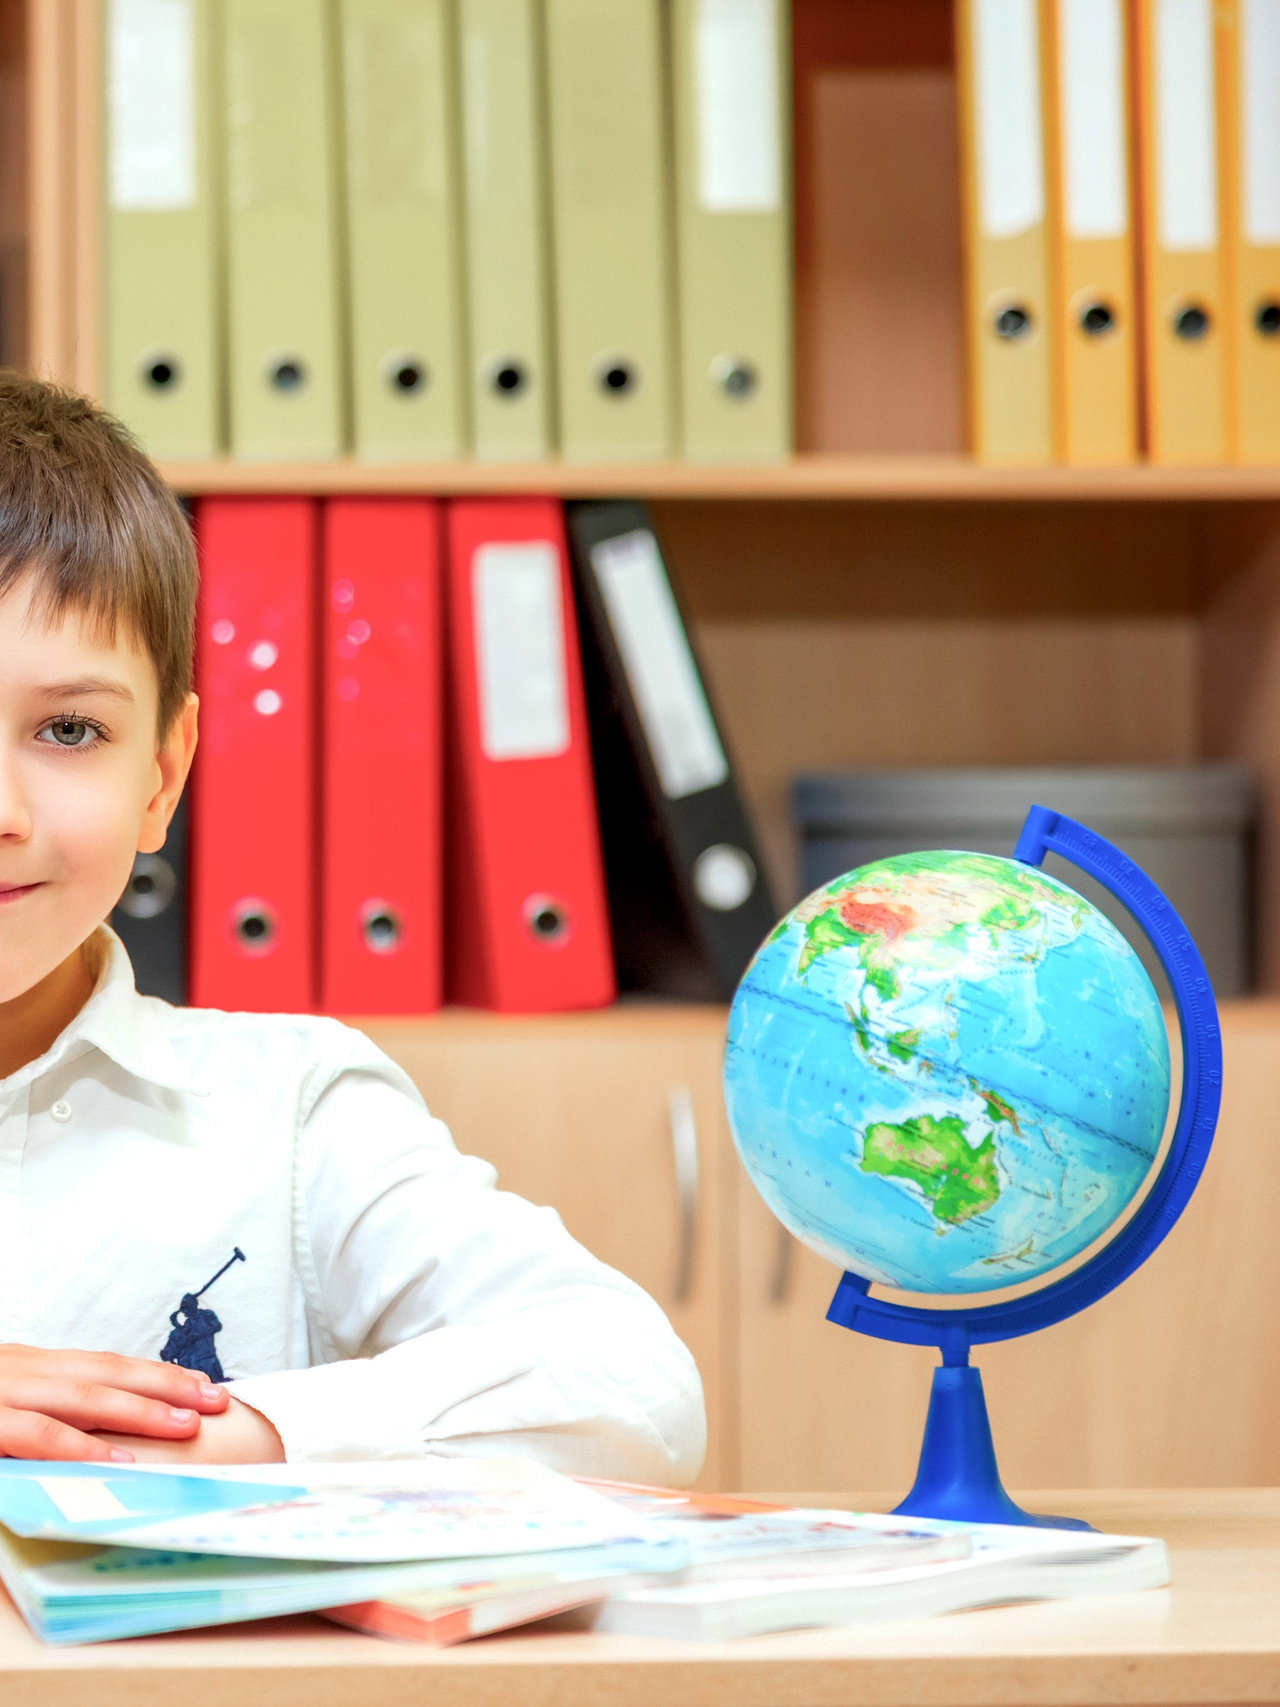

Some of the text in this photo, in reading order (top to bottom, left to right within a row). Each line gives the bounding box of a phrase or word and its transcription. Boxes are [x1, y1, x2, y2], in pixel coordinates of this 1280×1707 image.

[1082, 833, 1099, 849] 80
[1120, 860, 1135, 877] 70
[1151, 894, 1168, 911] 60
[1177, 934, 1192, 951] 50
[1195, 977, 1209, 993] 40
[1206, 1024, 1219, 1039] 30
[1208, 1069, 1220, 1086] 20
[1202, 1117, 1215, 1130] 10
